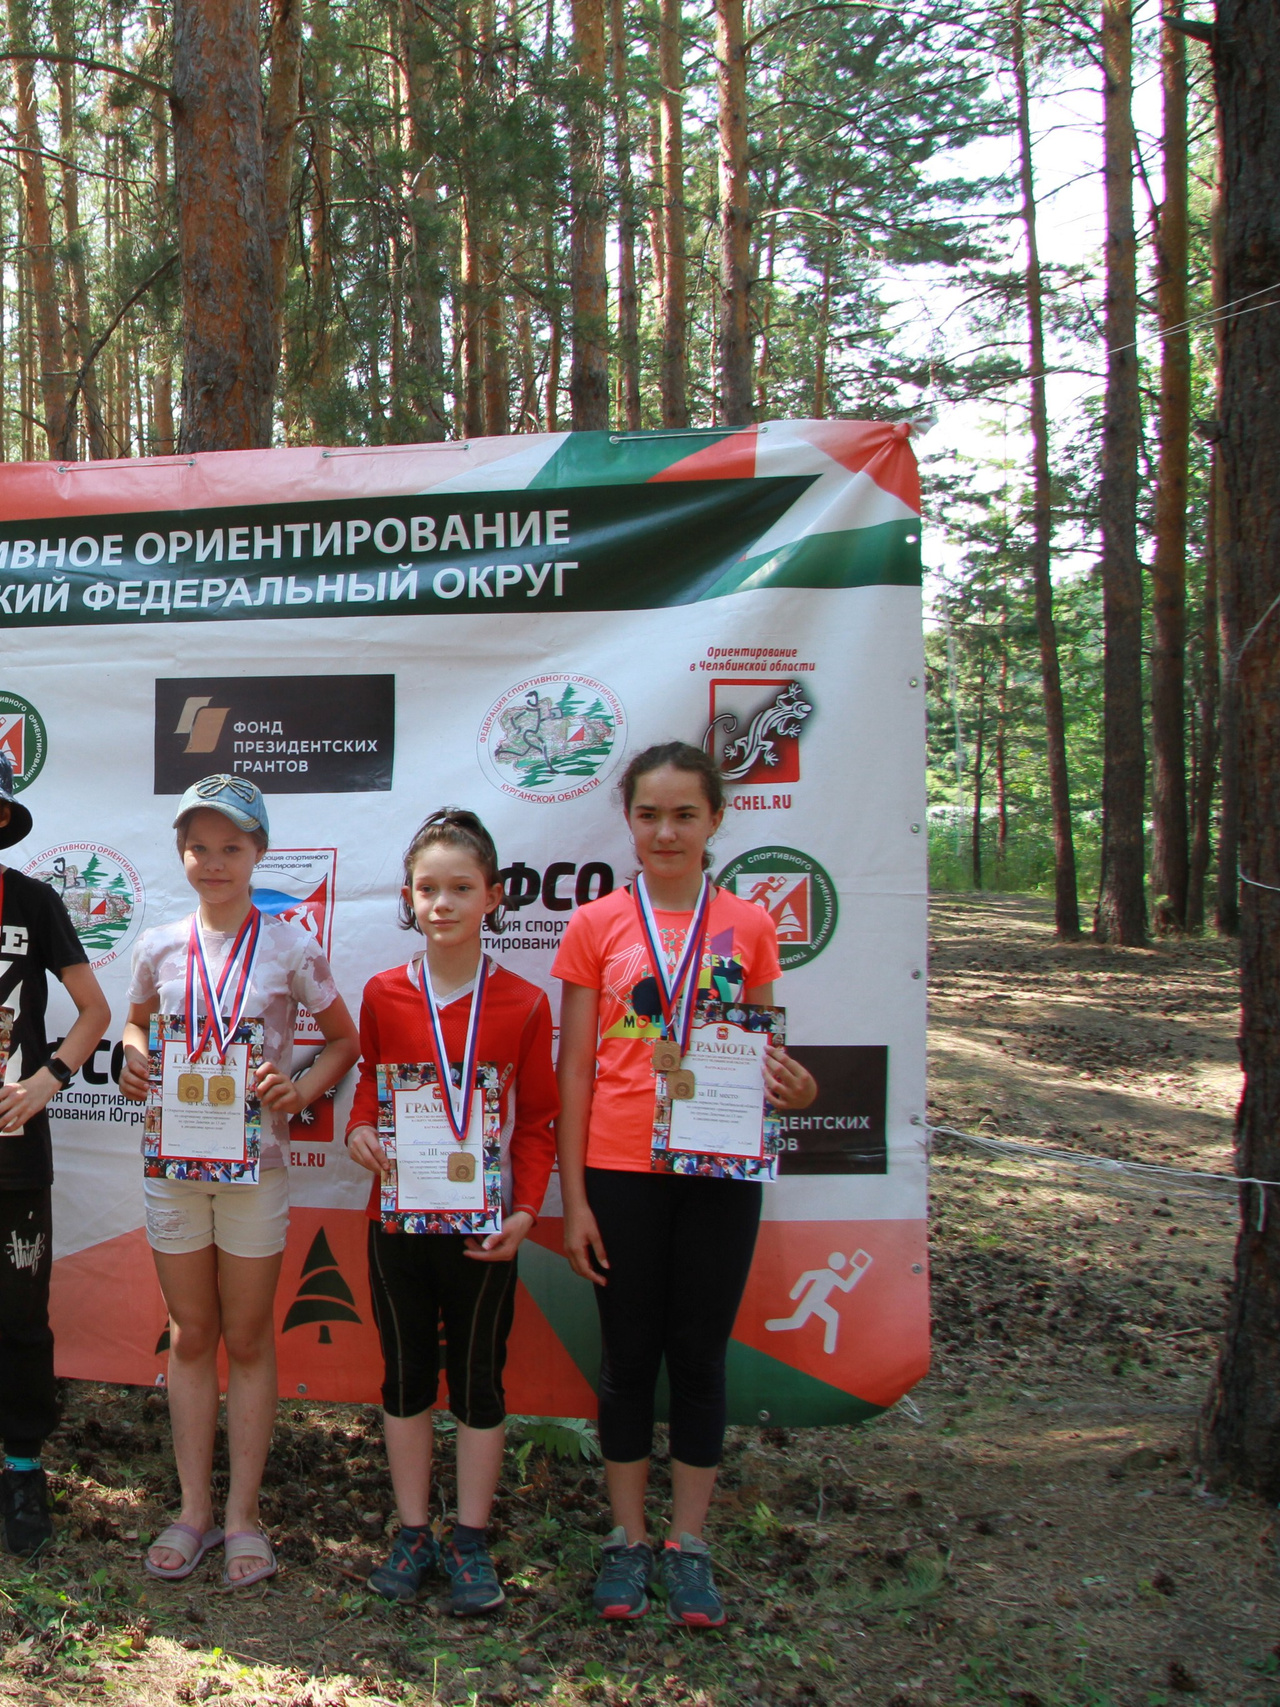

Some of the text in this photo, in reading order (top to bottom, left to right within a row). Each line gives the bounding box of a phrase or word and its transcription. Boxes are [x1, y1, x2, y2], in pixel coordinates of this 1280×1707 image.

[134, 509, 571, 566] ОРИЕНТИРОВАНИЕ
[82, 561, 419, 616] ФЕДЕРАЛЬНЫЙ
[431, 561, 579, 600] ОКРУГ
[707, 647, 798, 660] Ориентирование
[689, 659, 816, 672] в Челябинской области
[479, 674, 625, 744] ФЕДЕРАЦИЯ СПОРТИВНОГО ОРИЕНТИРОВАНИЯ
[233, 721, 283, 735] ФОНД
[22, 714, 43, 782] ОРИЕНТИРОВАНИЯ
[233, 739, 378, 754] ПРЕЗИДЕНТСКИХ
[233, 760, 309, 773] ГРАНТОВ
[500, 777, 601, 804] КУРГАНСКОЙ ОБЛАСТИ
[727, 794, 792, 811] -CHEL.RU
[260, 854, 285, 862] рация
[37, 843, 143, 903] СПОРТИВНОГО ОРИЕНТИРОВАНИЯ
[497, 861, 614, 912] ФСО
[720, 851, 833, 951] РАЦИЯ СПОРТИВНОГО ОРИЕНТИРОВАНИЯ
[481, 936, 561, 953] тировани
[90, 951, 118, 970] ЛАСТИ
[46, 1107, 106, 1121] рования
[779, 1116, 871, 1132] ДЕНТСКИХ
[290, 1151, 326, 1168] EL.RU
